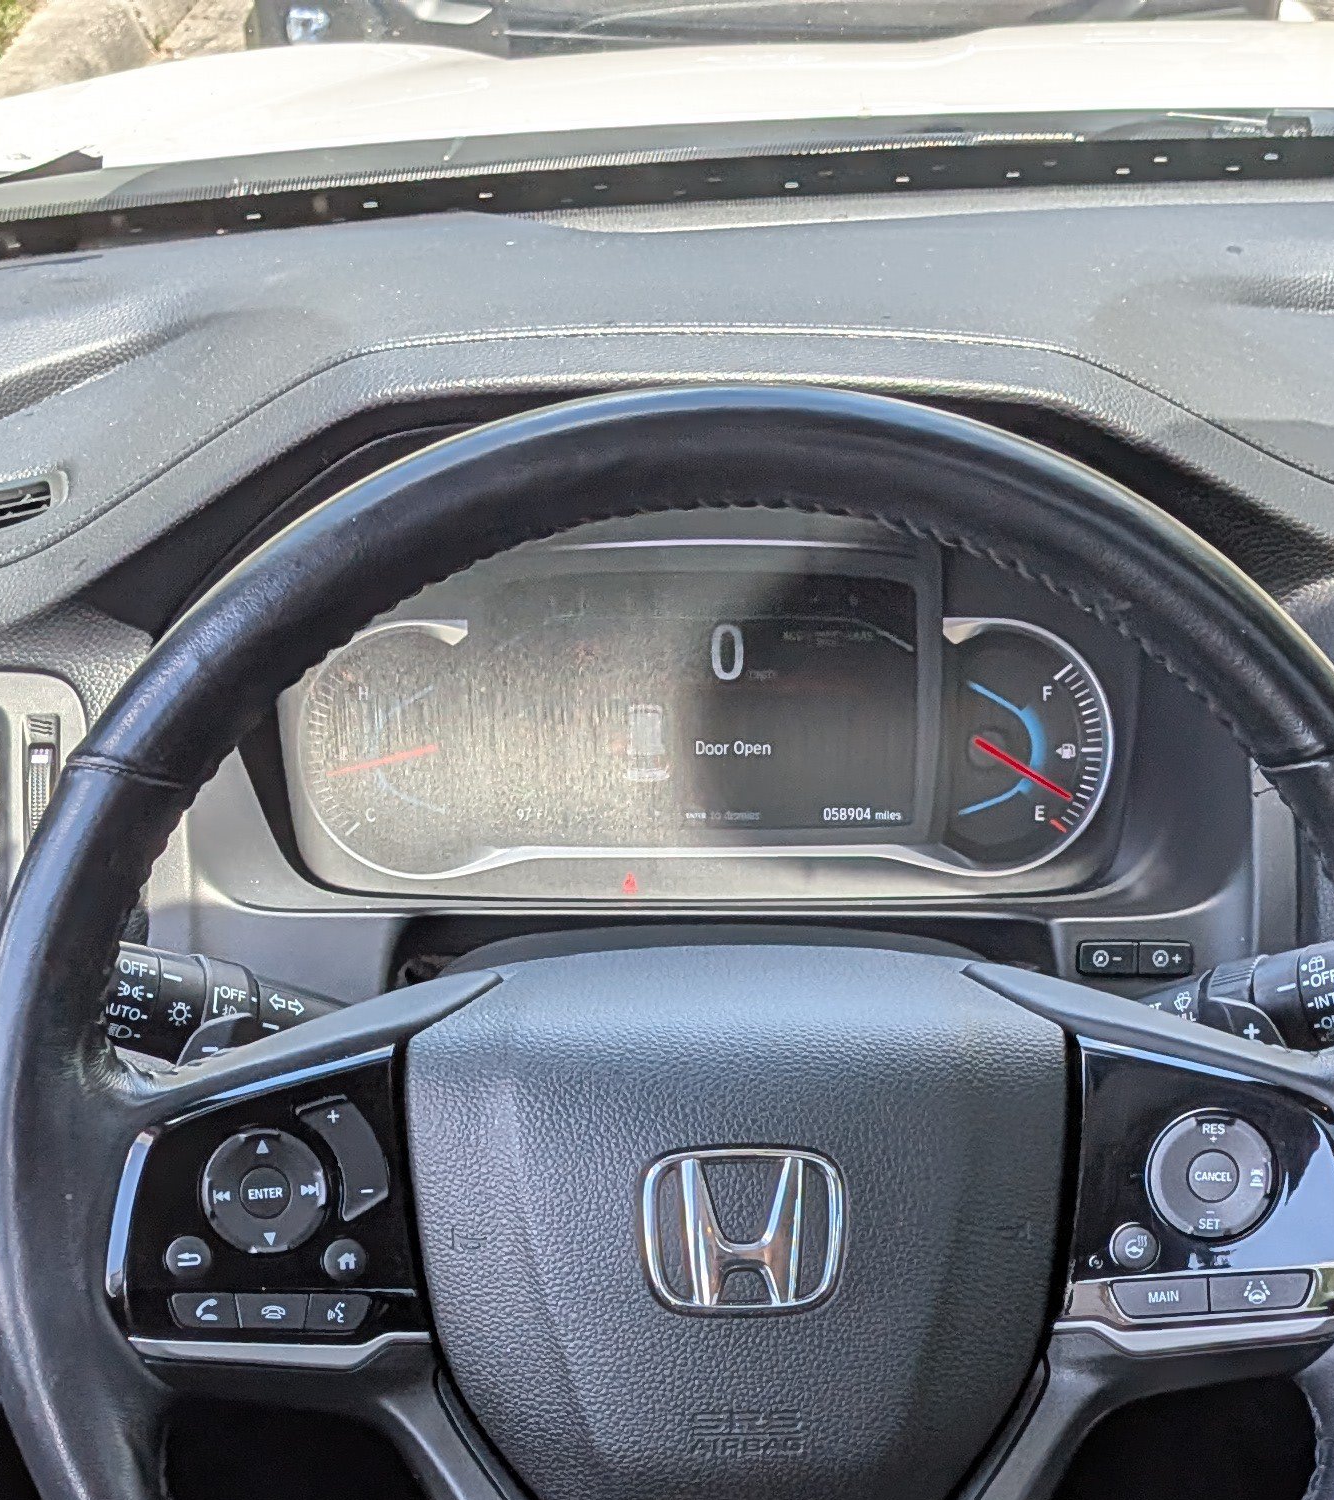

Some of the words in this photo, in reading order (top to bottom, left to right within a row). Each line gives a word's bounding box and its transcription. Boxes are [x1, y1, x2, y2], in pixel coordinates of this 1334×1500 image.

[711, 624, 744, 681] 0
[1042, 686, 1052, 701] F
[695, 741, 729, 755] Door
[733, 741, 772, 757] Open
[823, 807, 871, 821] 058904
[875, 811, 902, 820] miles
[1034, 806, 1044, 821] E
[120, 959, 148, 978] OFF
[220, 986, 247, 1002] OFF
[1202, 1123, 1225, 1135] RES
[1194, 1170, 1232, 1183] CANCEL
[248, 1186, 283, 1199] ENTER
[1198, 1217, 1220, 1230] SET
[1148, 1290, 1179, 1303] MAIN
